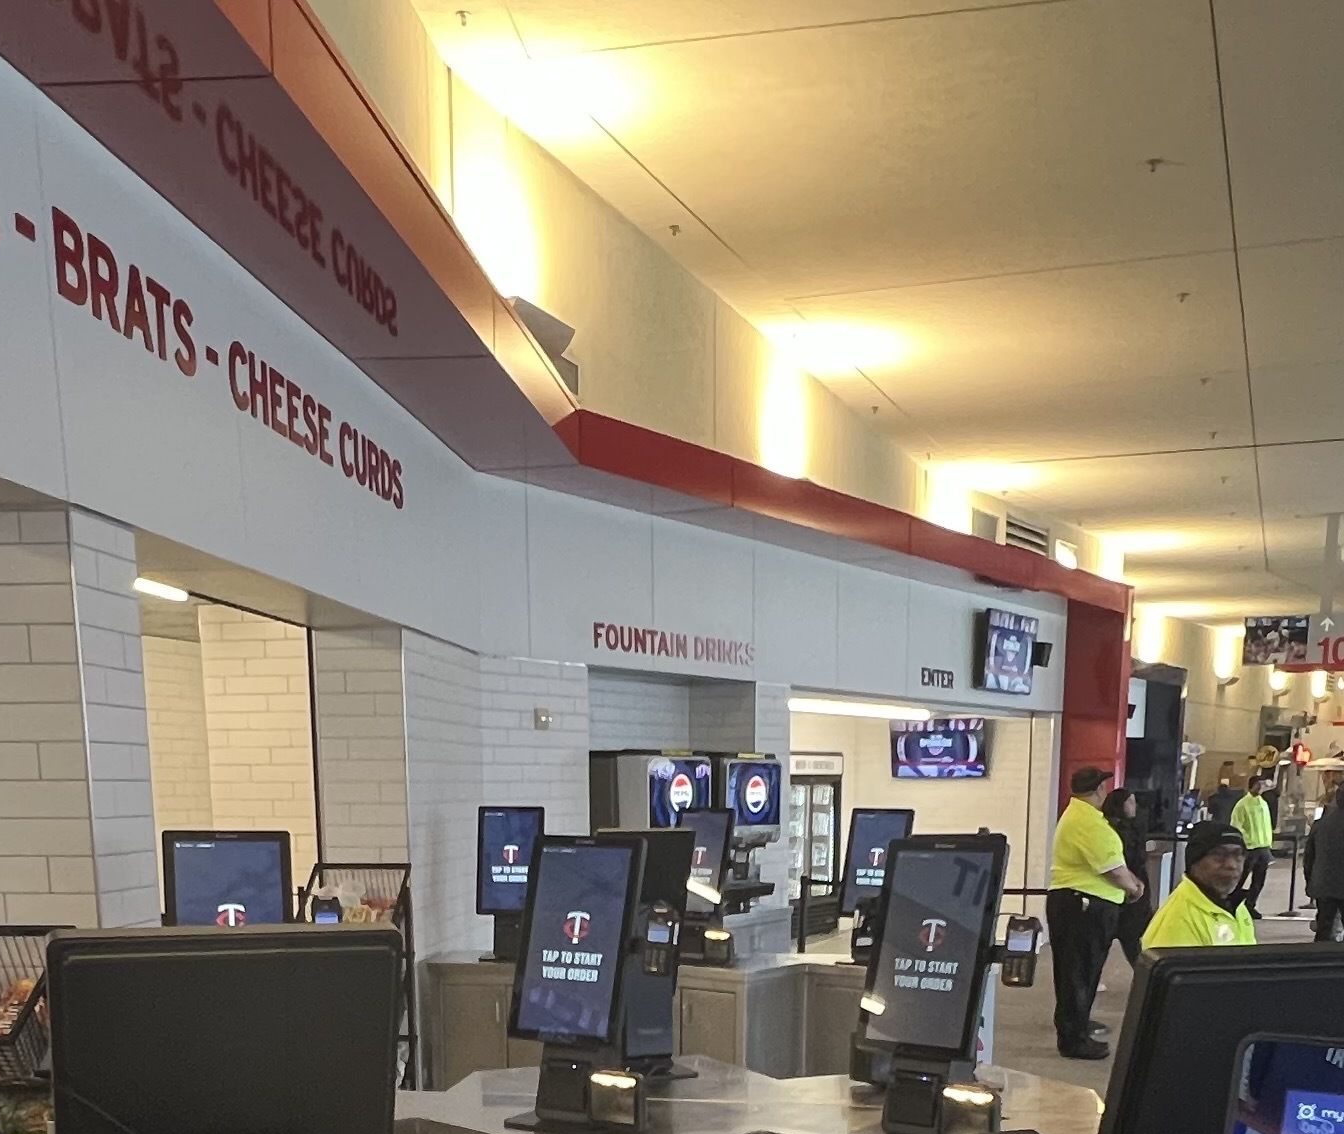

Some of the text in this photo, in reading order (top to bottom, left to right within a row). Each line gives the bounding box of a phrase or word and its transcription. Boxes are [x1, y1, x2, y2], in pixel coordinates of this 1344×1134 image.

[52, 205, 197, 377] BRATS
[228, 340, 333, 486] CHEESE
[339, 421, 404, 510] CURDS
[593, 621, 755, 666] FOUNTAIN DRINKS
[921, 667, 954, 689] ENTER
[542, 949, 603, 967] TAP TO START
[894, 957, 959, 975] TAP TO START
[542, 966, 599, 983] YOUR ORDER
